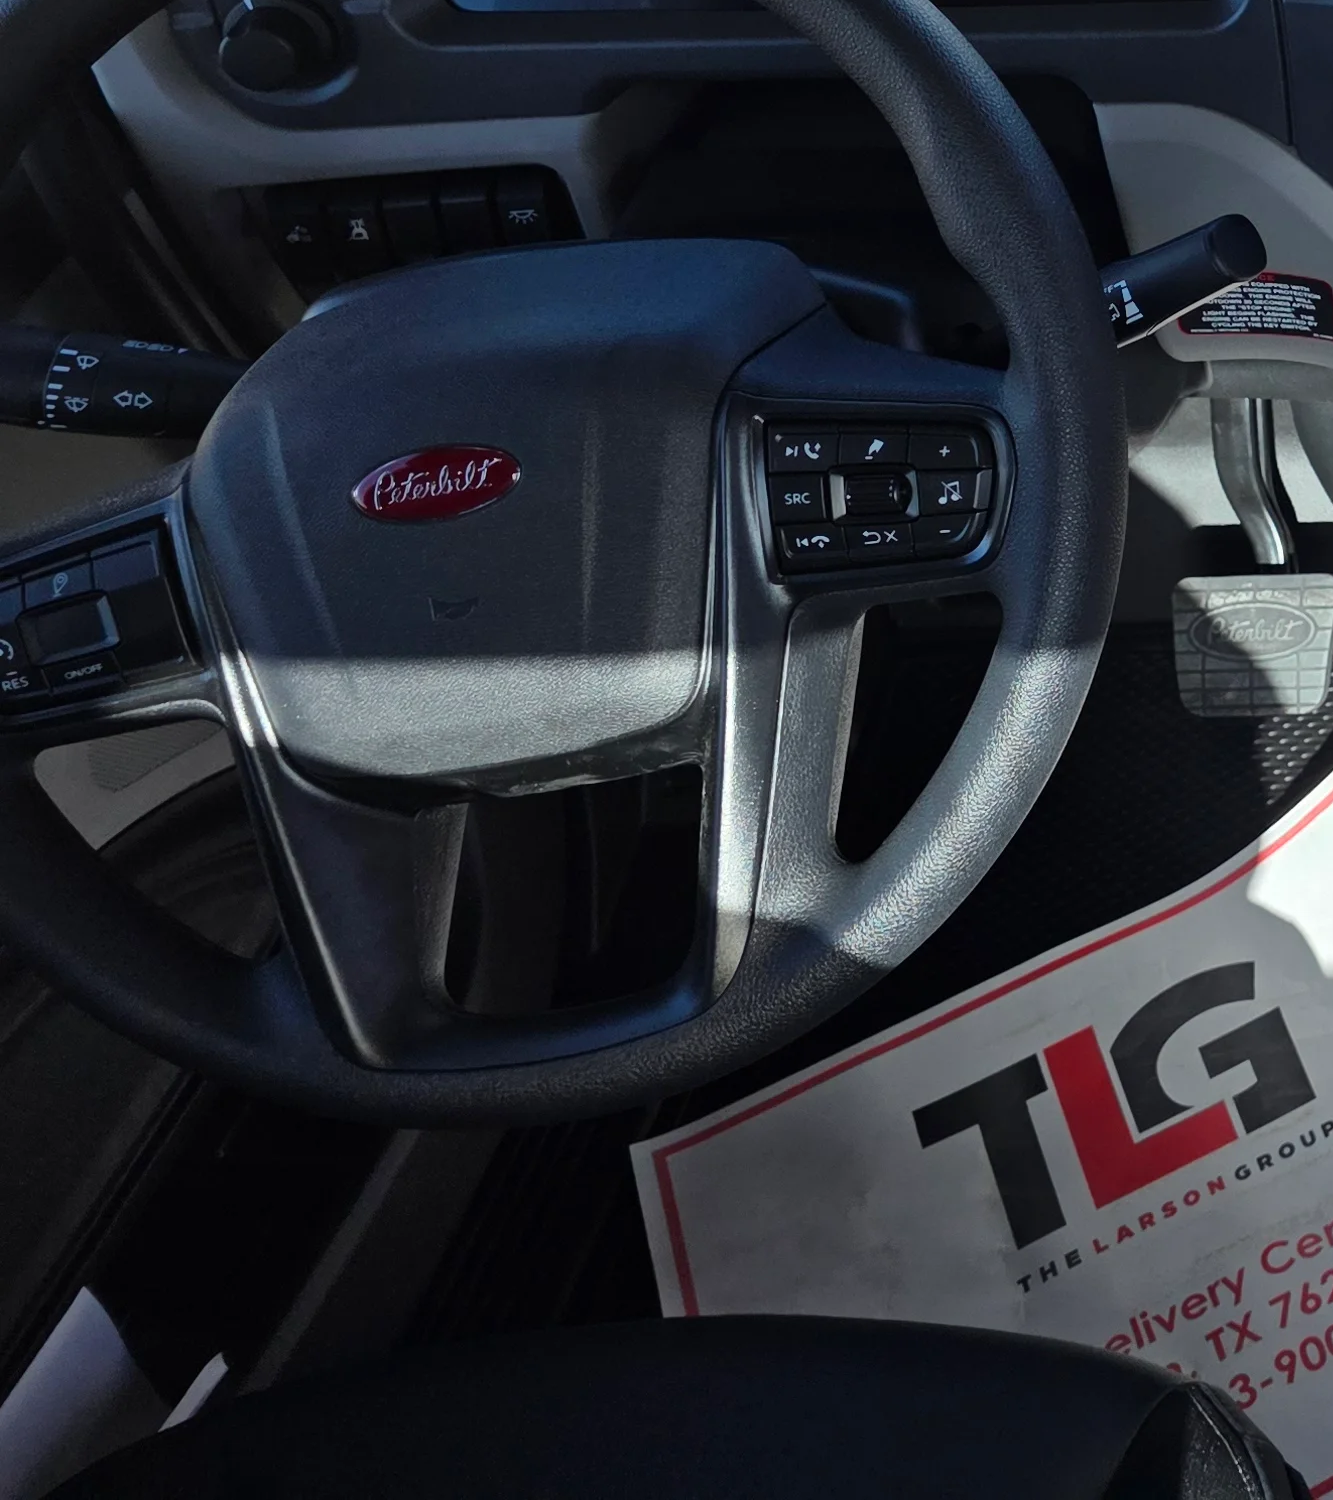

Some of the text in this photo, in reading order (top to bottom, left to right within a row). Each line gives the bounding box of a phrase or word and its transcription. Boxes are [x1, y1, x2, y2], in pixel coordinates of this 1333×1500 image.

[372, 455, 505, 511] Peterbilt
[783, 491, 811, 506] SRC
[1, 675, 30, 693] RES
[63, 663, 104, 680] ON/OFF
[912, 960, 1317, 1251] TLG
[1016, 1248, 1083, 1294] THE
[1092, 1175, 1227, 1255] LARSON
[1103, 1266, 1246, 1357] elivery
[1204, 1310, 1263, 1362] TX
